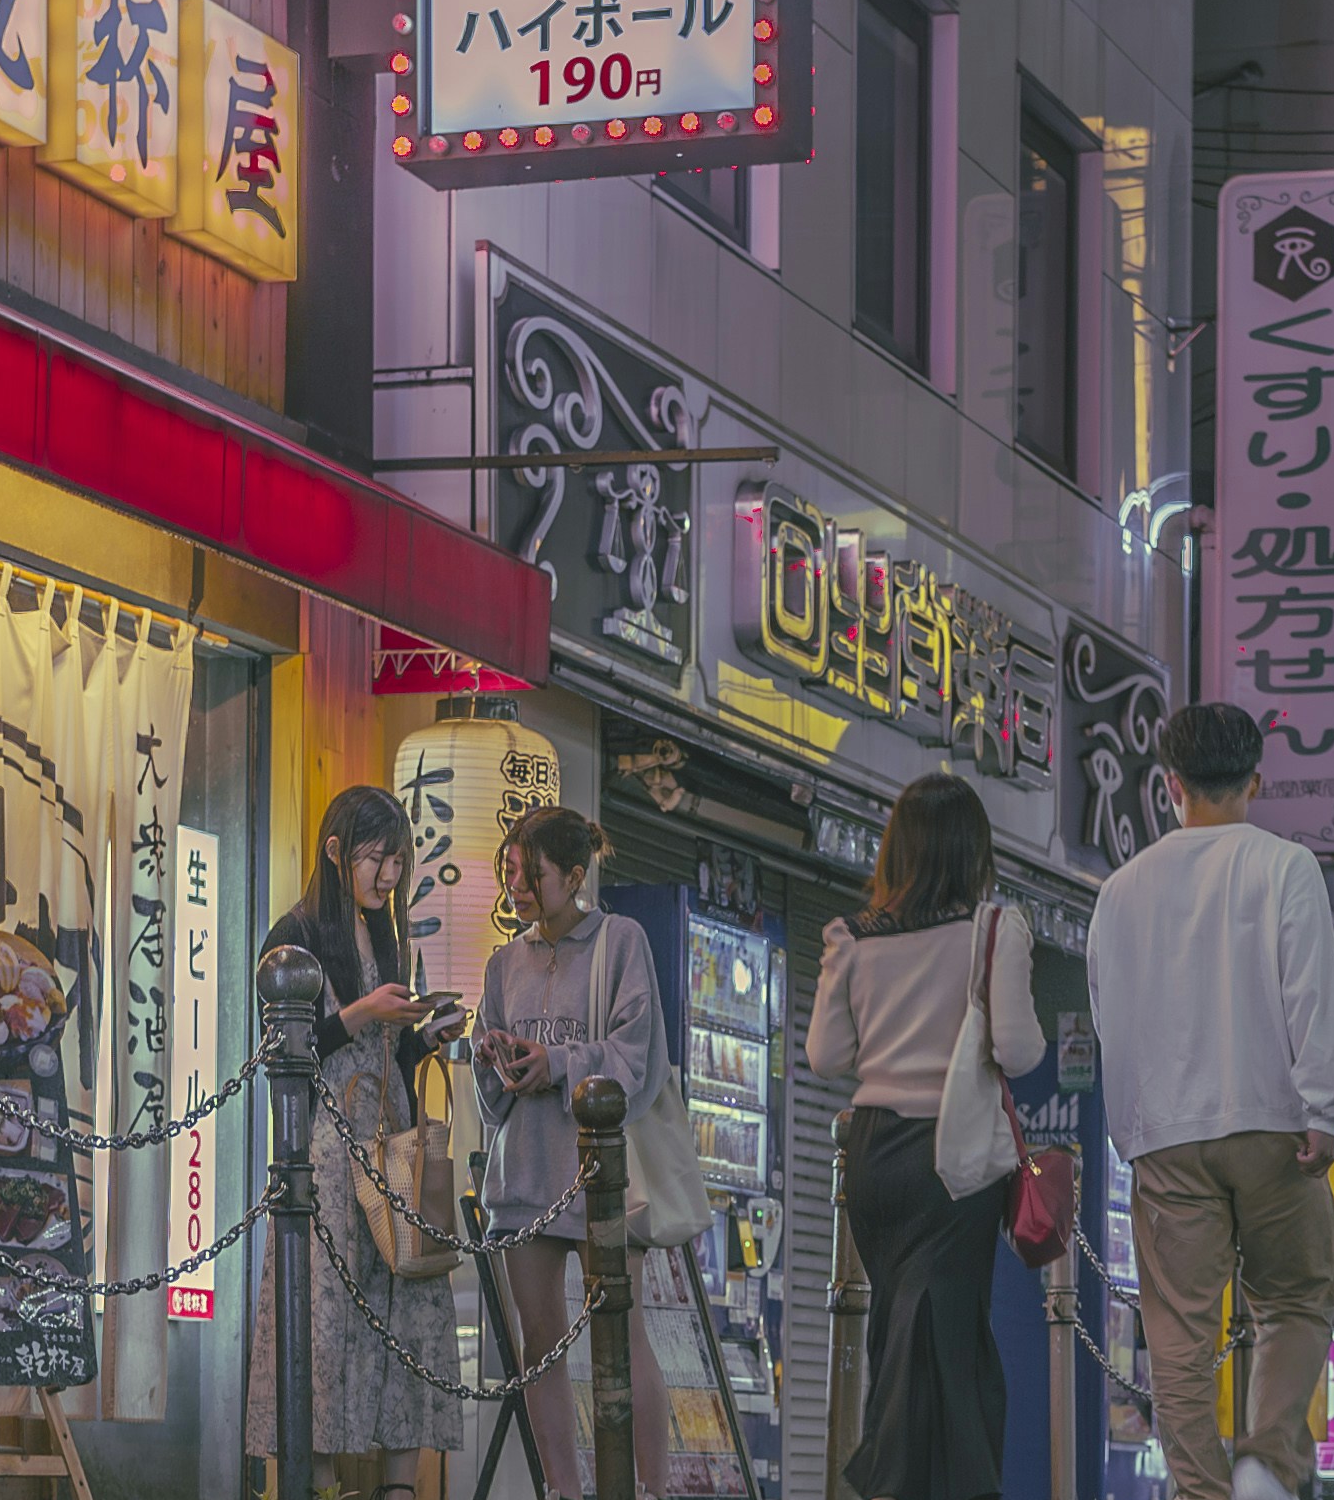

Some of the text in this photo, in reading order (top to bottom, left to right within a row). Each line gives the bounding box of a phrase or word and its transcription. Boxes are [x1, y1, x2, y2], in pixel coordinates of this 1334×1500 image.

[529, 53, 663, 107] 190円
[185, 849, 210, 1118] 生ビール
[1014, 1093, 1079, 1131] sahi
[1025, 1131, 1078, 1144] DRINKS
[186, 1129, 203, 1254] 280
[15, 1341, 86, 1379] 乾杯屋
